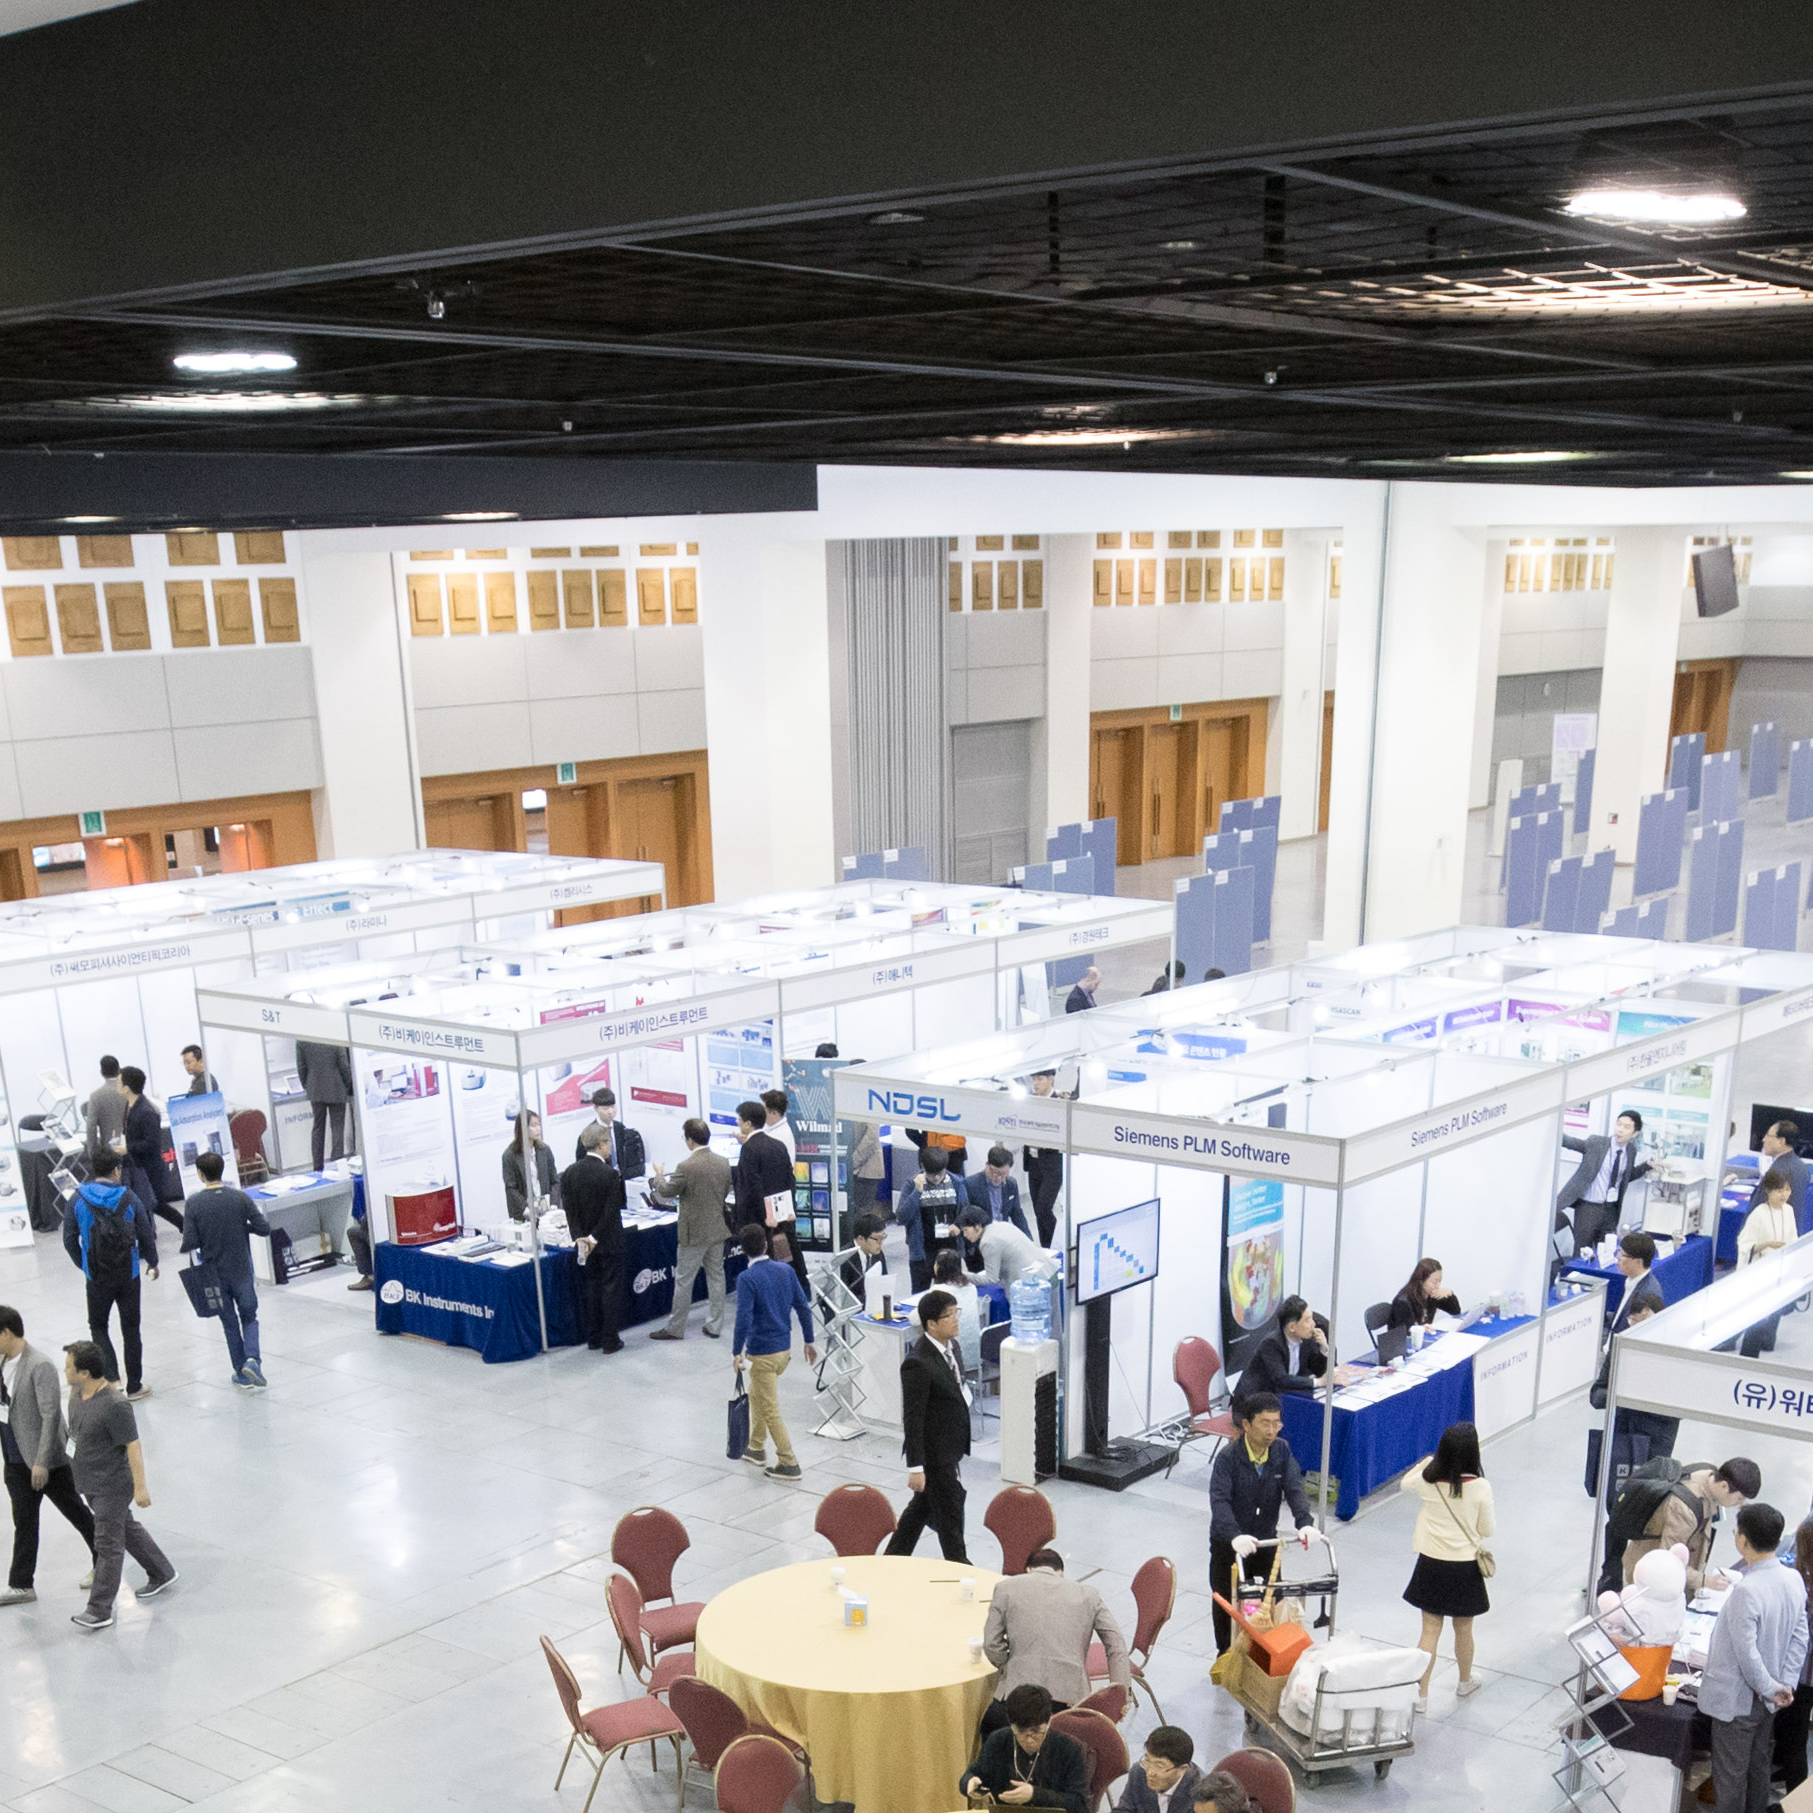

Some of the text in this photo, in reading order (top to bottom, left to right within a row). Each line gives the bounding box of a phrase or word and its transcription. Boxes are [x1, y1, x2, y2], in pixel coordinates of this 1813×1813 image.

[261, 1008, 281, 1023] S&T
[598, 1007, 708, 1042] (주)비케이인스트루먼트
[378, 1024, 485, 1053] (주)비케이인스트루먼트
[868, 1088, 962, 1122] NDSL
[1410, 1103, 1507, 1148] Siemens PLM Software
[1113, 1126, 1291, 1165] Siemens PLM Software
[651, 1267, 667, 1284] BK
[404, 1288, 422, 1305] BK
[422, 1292, 484, 1318] Instruments
[1545, 1315, 1593, 1343] INFORMATION
[1479, 1351, 1529, 1381] INFORMATION
